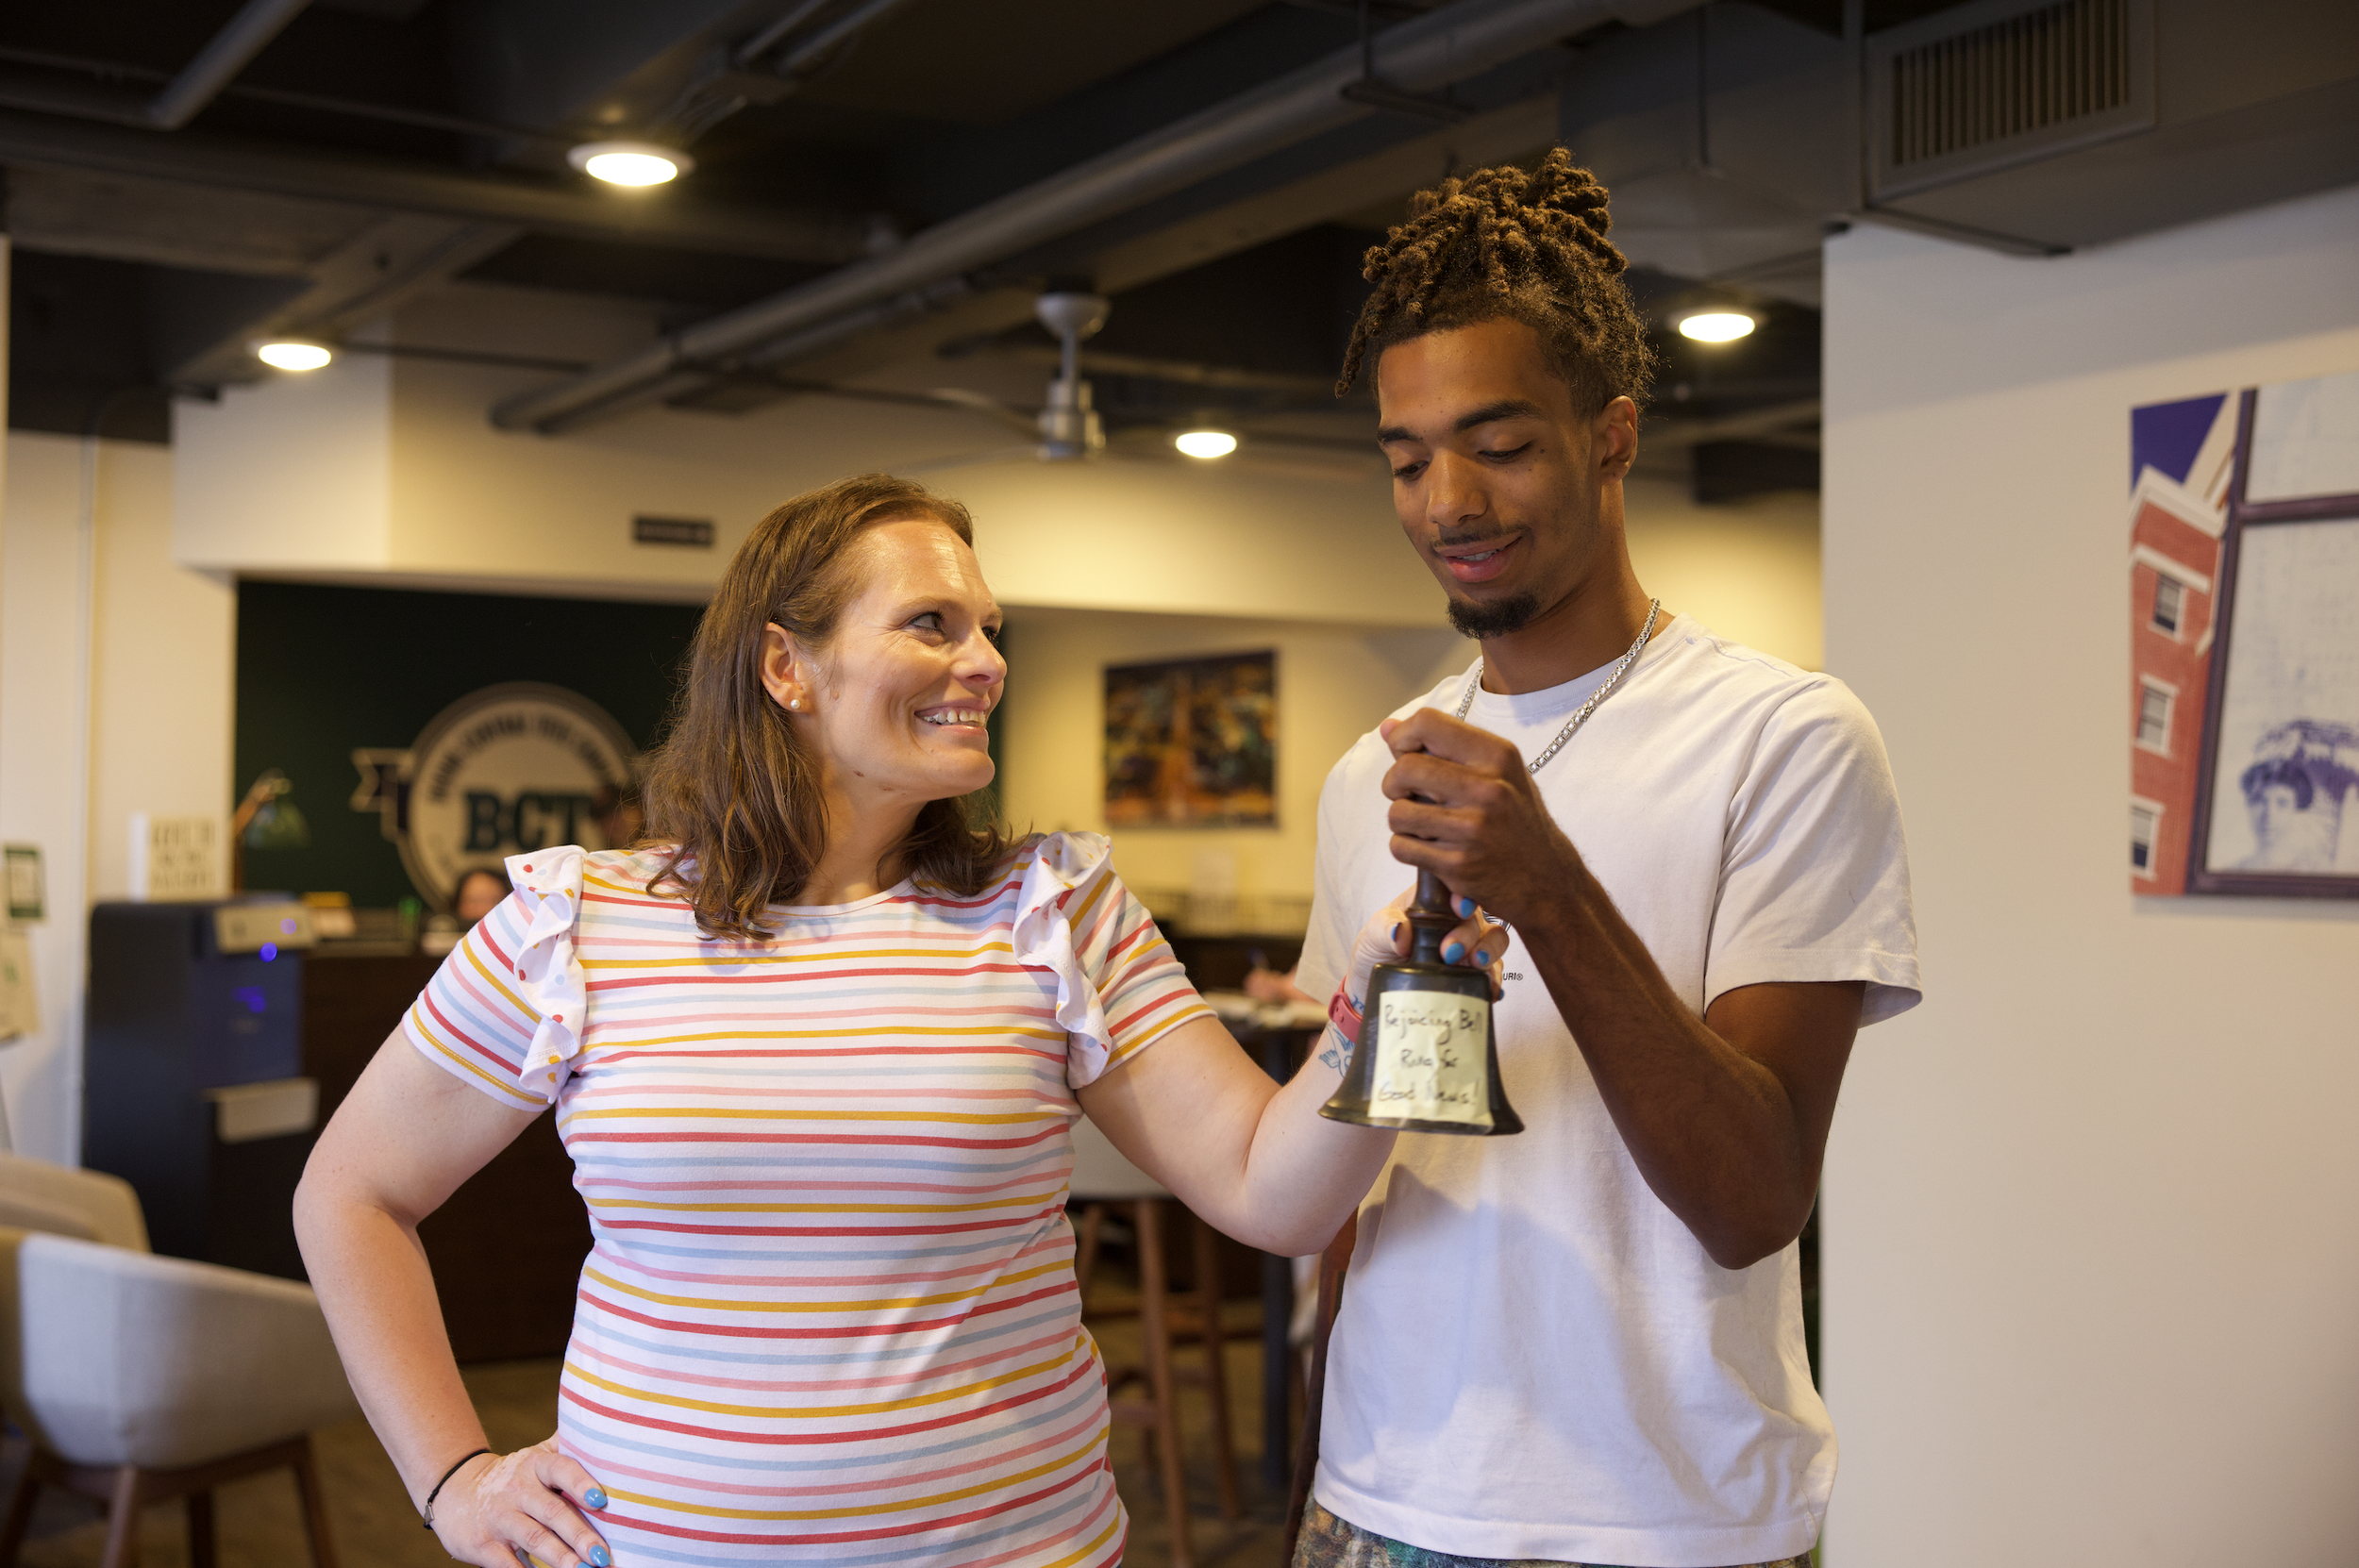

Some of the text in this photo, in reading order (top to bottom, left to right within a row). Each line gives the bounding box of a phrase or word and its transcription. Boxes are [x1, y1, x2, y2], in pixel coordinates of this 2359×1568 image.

[465, 792, 594, 851] BCT
[1384, 1004, 1452, 1045] Rejoicing
[1440, 1048, 1459, 1069] for
[1378, 1081, 1415, 1102] Good
